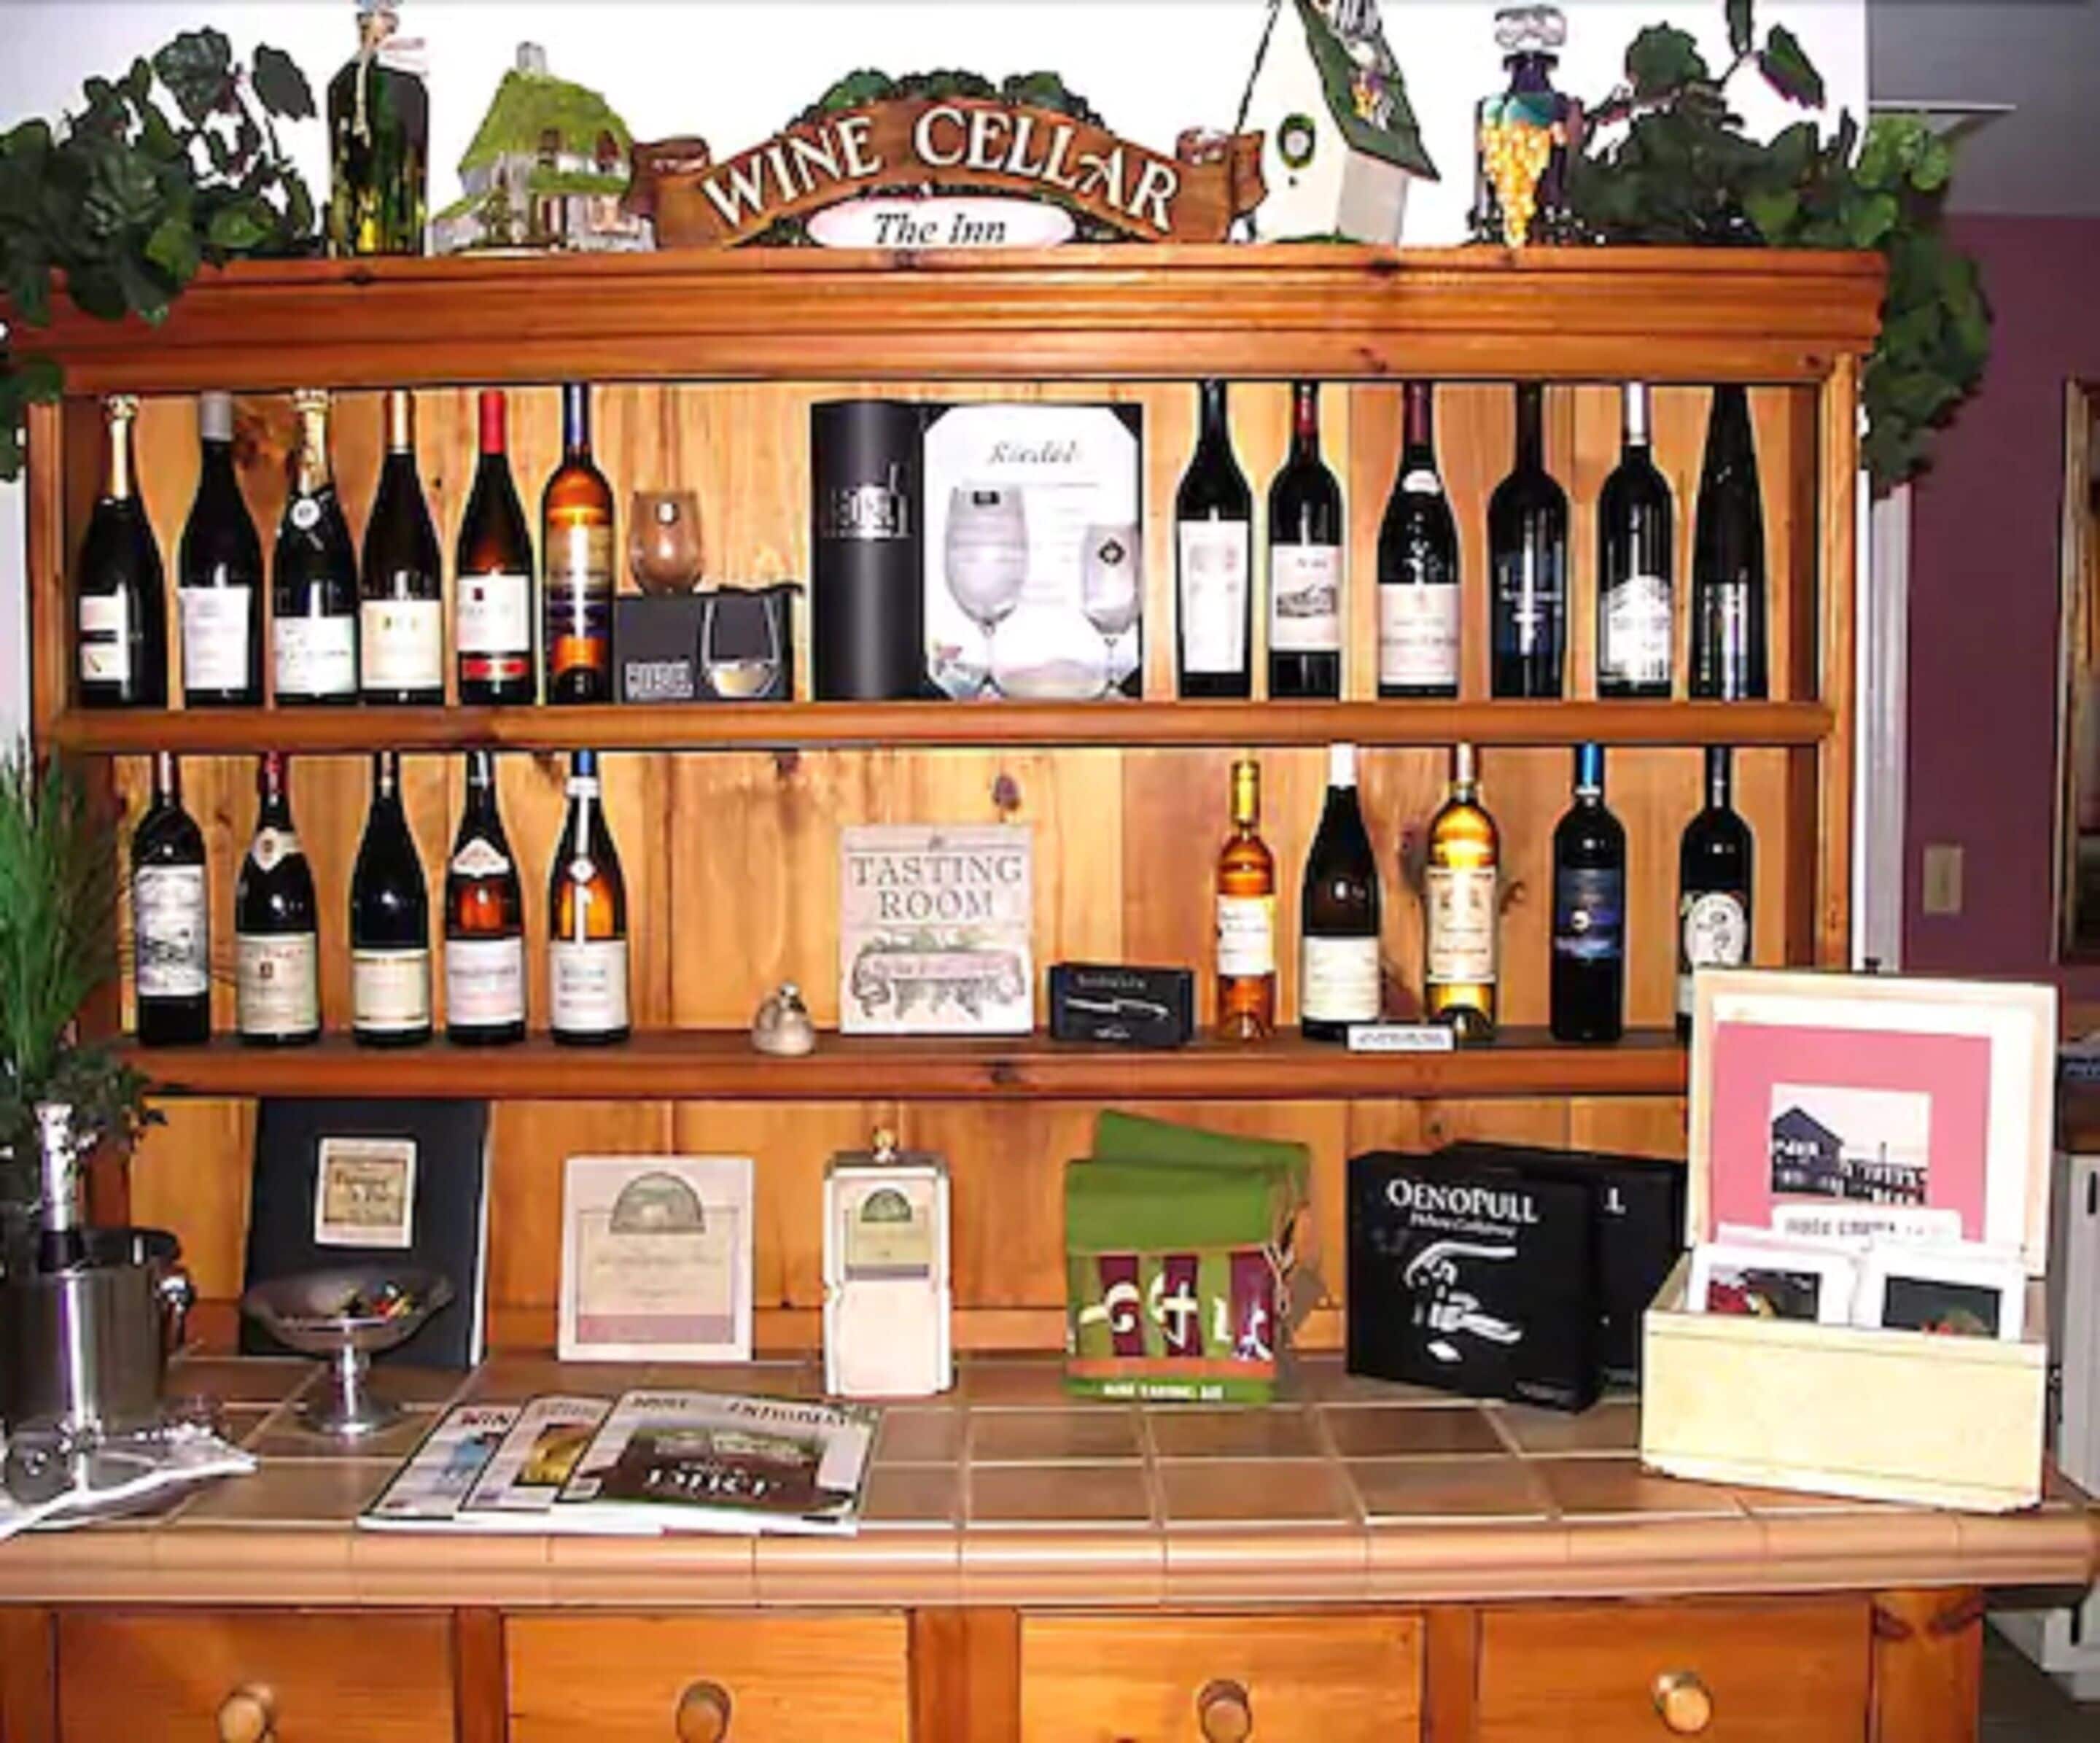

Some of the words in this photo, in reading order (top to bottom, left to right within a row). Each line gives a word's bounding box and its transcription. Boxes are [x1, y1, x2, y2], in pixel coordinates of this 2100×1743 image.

[701, 115, 881, 230] WINE
[915, 108, 1179, 233] CELLAR
[874, 212, 938, 244] The
[948, 212, 1006, 244] Inn
[849, 855, 1022, 886] TASTING
[877, 889, 994, 919] ROOM
[1386, 1178, 1539, 1223] OENOPULL
